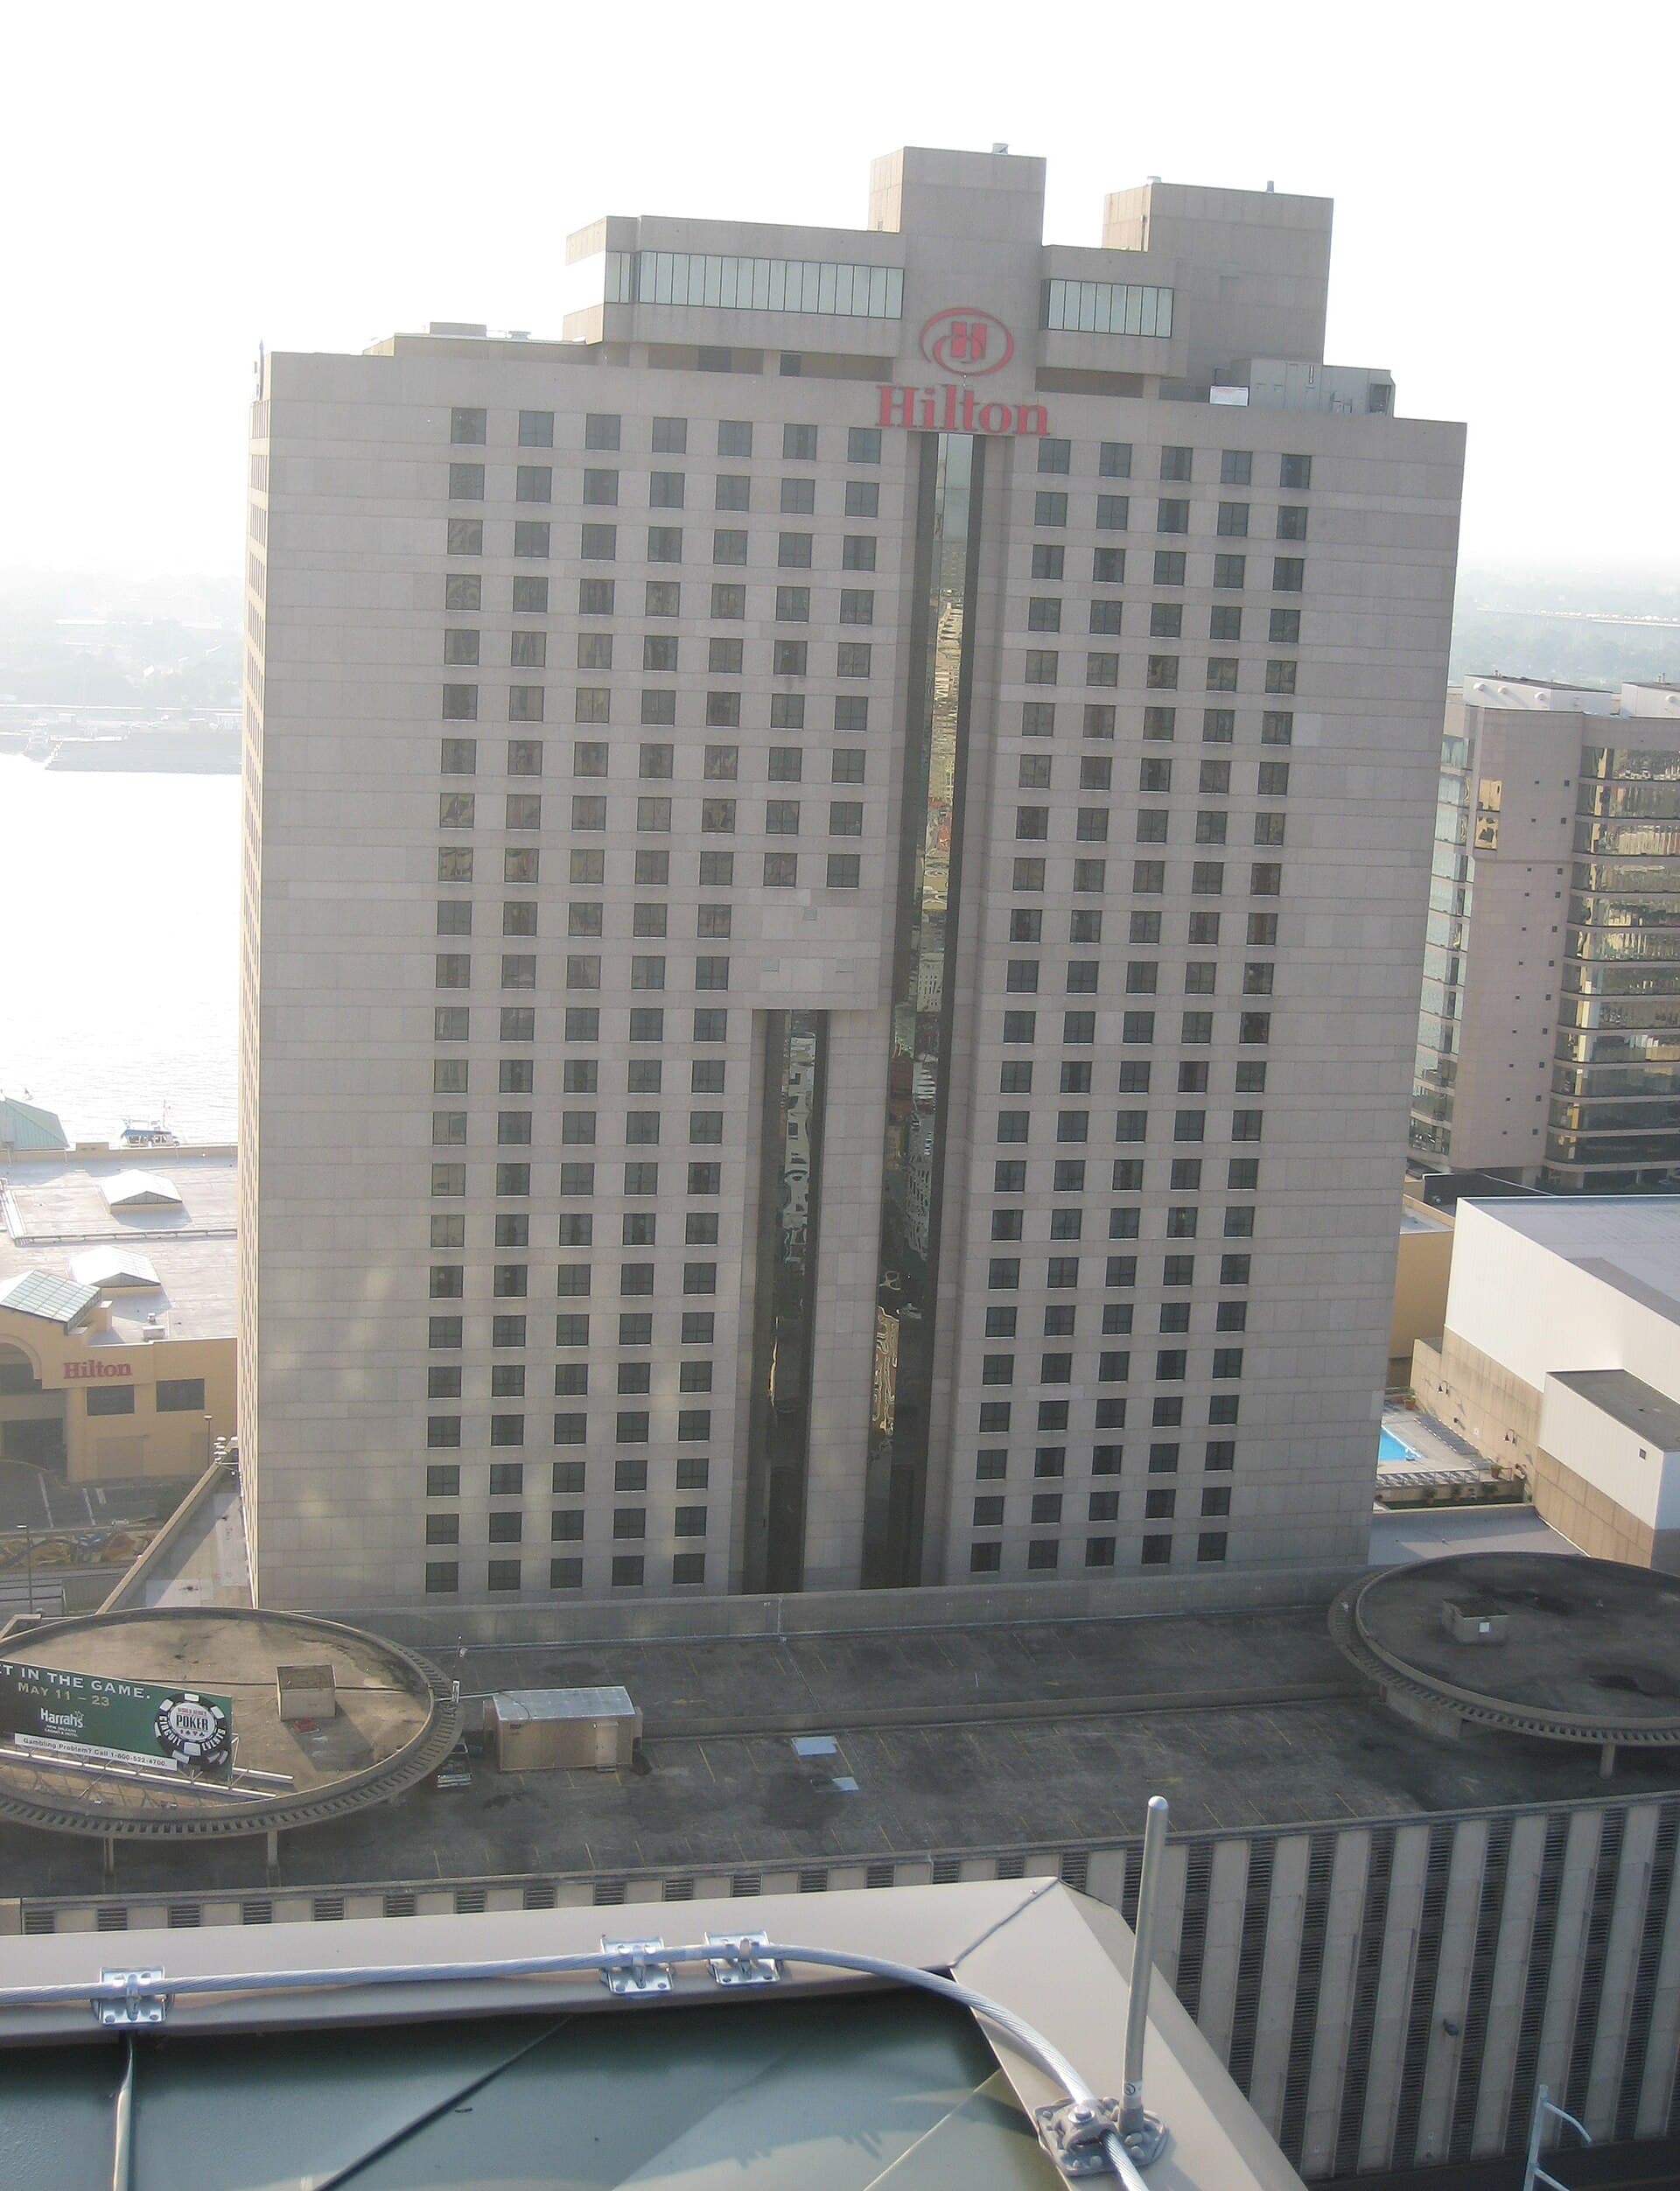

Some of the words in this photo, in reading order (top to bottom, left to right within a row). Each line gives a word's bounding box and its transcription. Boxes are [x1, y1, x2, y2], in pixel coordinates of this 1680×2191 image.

[876, 383, 1050, 436] Hilton
[63, 1360, 132, 1379] Hilton
[18, 1682, 50, 1697] MAY
[55, 1690, 71, 1701] 11
[91, 1695, 110, 1707] 23
[21, 1667, 39, 1680] IN
[47, 1672, 84, 1689] THE
[91, 1680, 150, 1699] GAME.
[158, 1715, 183, 1746] CIRCUIT
[200, 1728, 227, 1751] EVENTS
[176, 1714, 209, 1732] POKER
[23, 1737, 57, 1750] Gambling
[59, 1743, 92, 1754] Problem?
